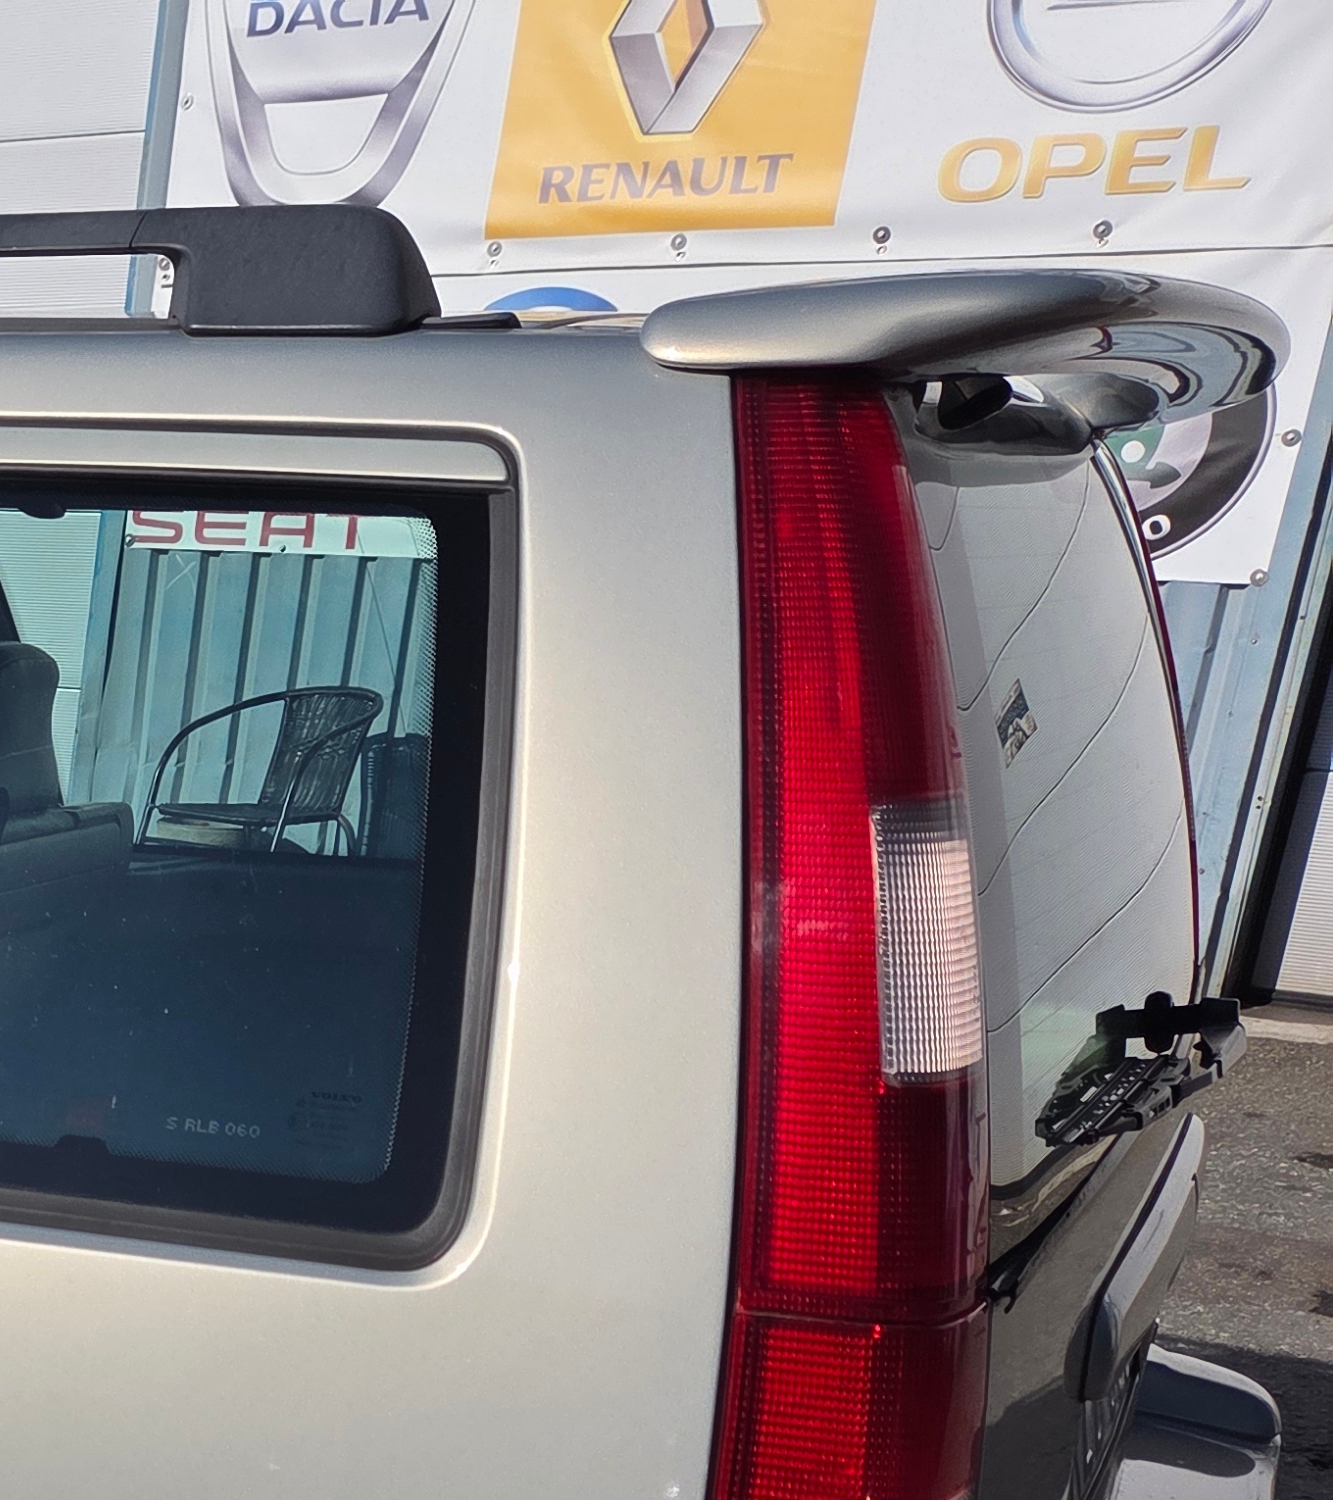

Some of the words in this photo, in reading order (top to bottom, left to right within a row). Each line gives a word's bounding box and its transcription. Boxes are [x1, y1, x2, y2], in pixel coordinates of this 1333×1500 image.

[246, 0, 430, 37] DACIA
[538, 153, 794, 204] RENAULT
[937, 125, 1251, 203] OPEL
[132, 510, 359, 550] SEAT
